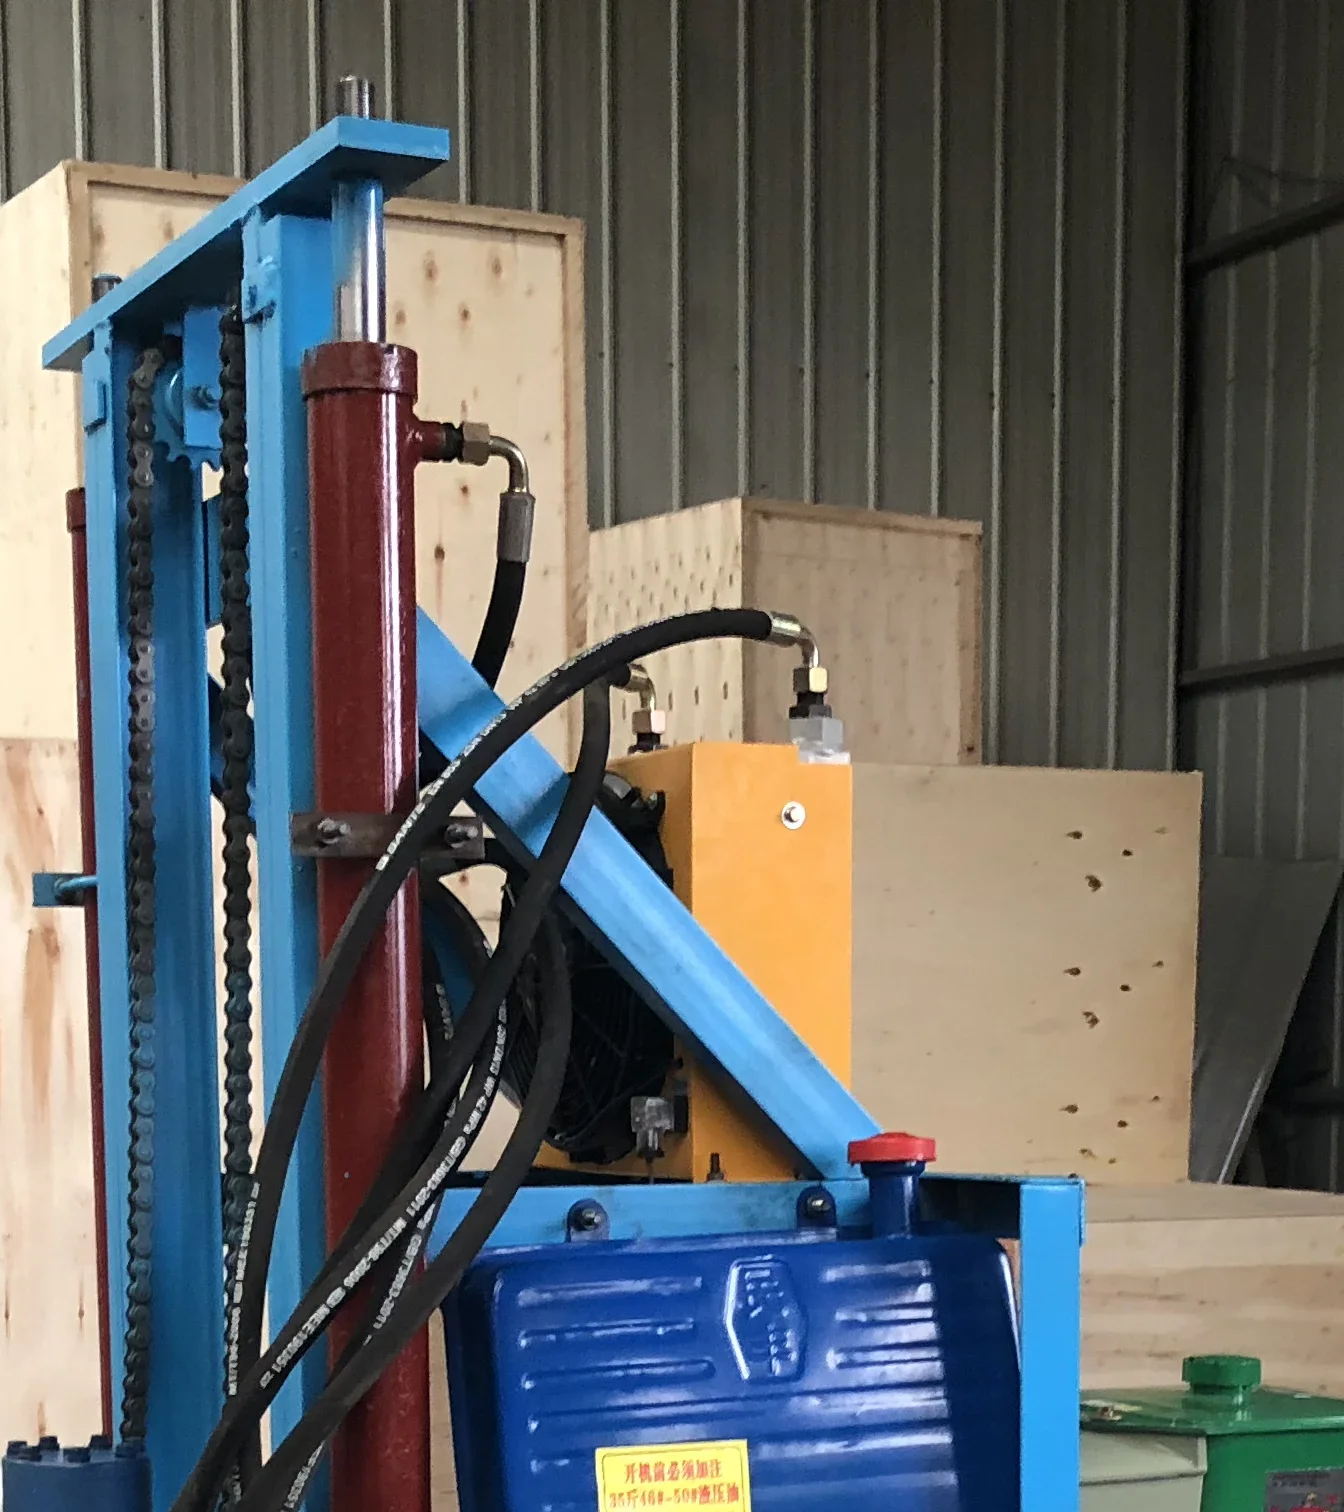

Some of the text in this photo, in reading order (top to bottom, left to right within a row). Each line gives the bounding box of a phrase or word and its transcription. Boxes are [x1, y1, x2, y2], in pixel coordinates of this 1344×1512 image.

[624, 1458, 723, 1484] 开机前必须加注
